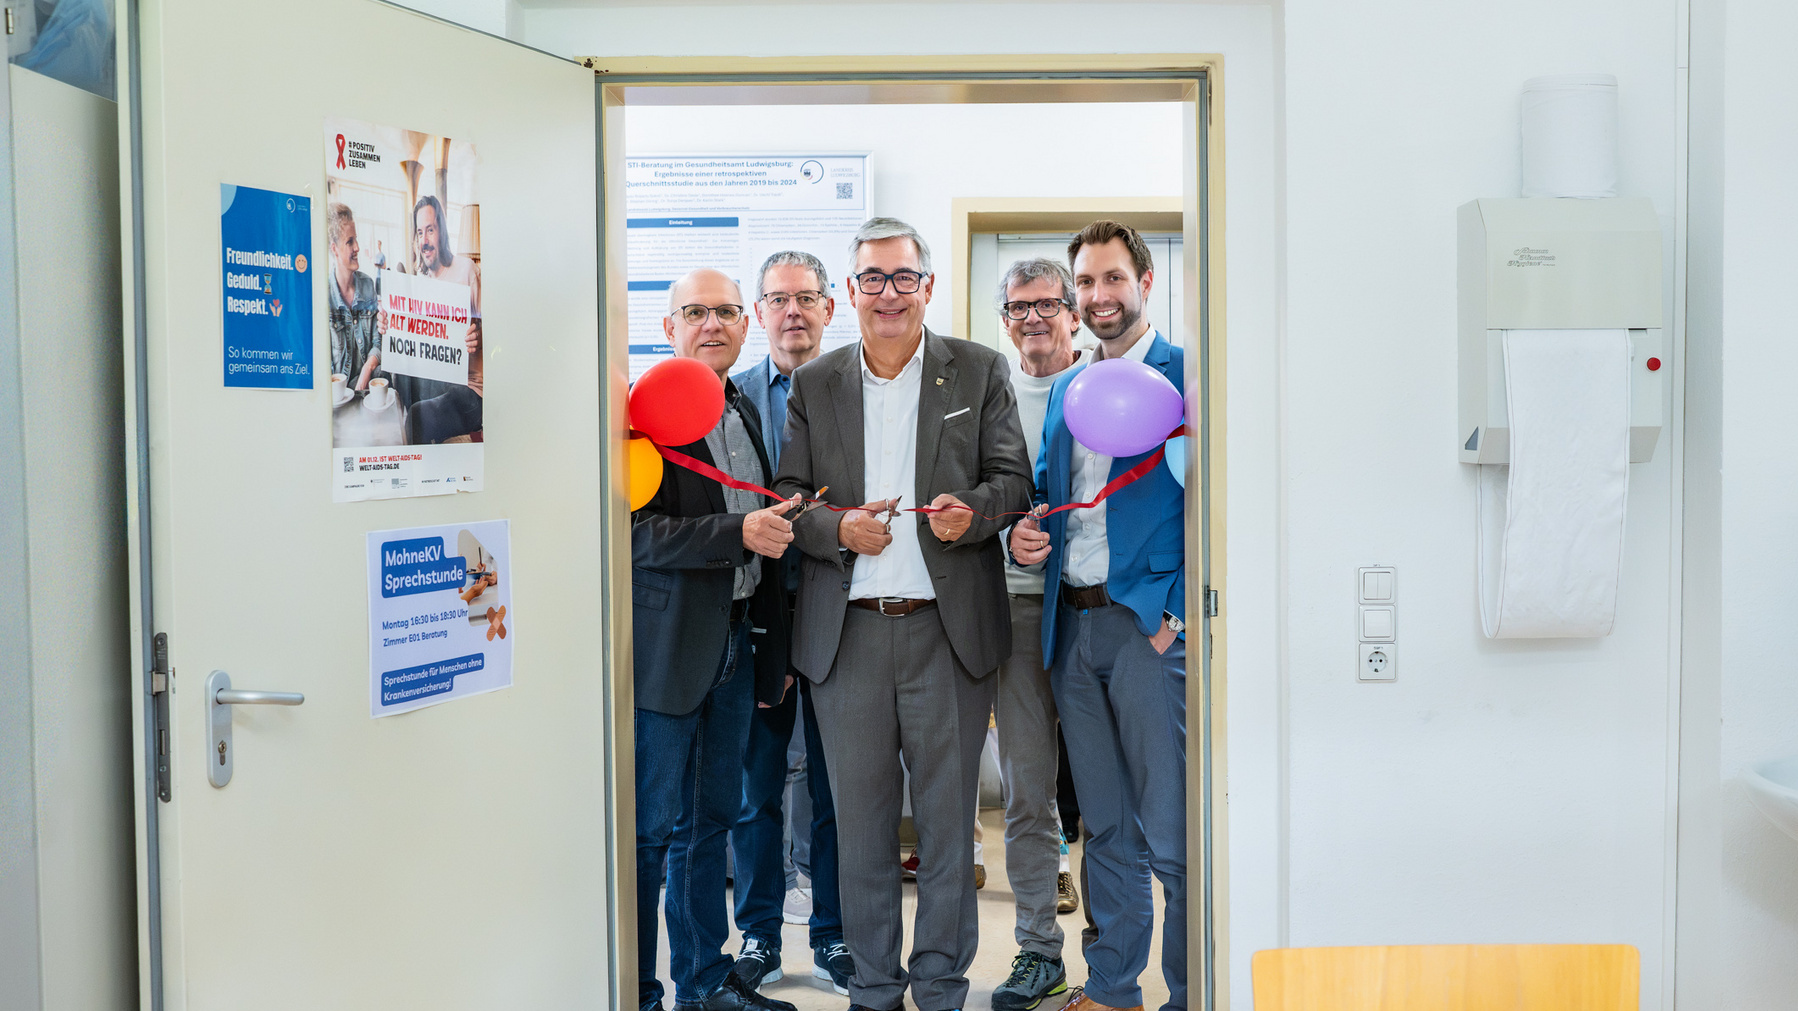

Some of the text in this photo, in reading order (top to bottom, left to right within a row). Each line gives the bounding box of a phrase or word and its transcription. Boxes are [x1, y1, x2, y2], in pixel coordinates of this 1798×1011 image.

[349, 150, 381, 162] ZUSAMMEN
[349, 159, 366, 169] LEBEN
[226, 247, 294, 270] Freundlichkeit.
[226, 272, 262, 290] Geduld.
[227, 296, 269, 316] Respekt.
[389, 294, 468, 324] MIT HIV KANN ICH
[390, 313, 449, 340] ALT WERDEN.
[228, 346, 294, 360] So kommen wir
[390, 336, 462, 366] NOCH FRAGEN?
[228, 362, 311, 375] gemeinsam ans Ziel.
[359, 463, 400, 472] WELT-AIDS-TAG.DE
[385, 544, 442, 567] MohneKV
[384, 564, 464, 594] Sprechstunde
[382, 608, 468, 632] Montag 16:30 bis 18:30 Uhr
[383, 630, 448, 648] Zimmer E01 Beratung
[384, 658, 482, 688] Sprechstunde für Menschen ohne
[384, 678, 452, 702] Krankenversicherung!
